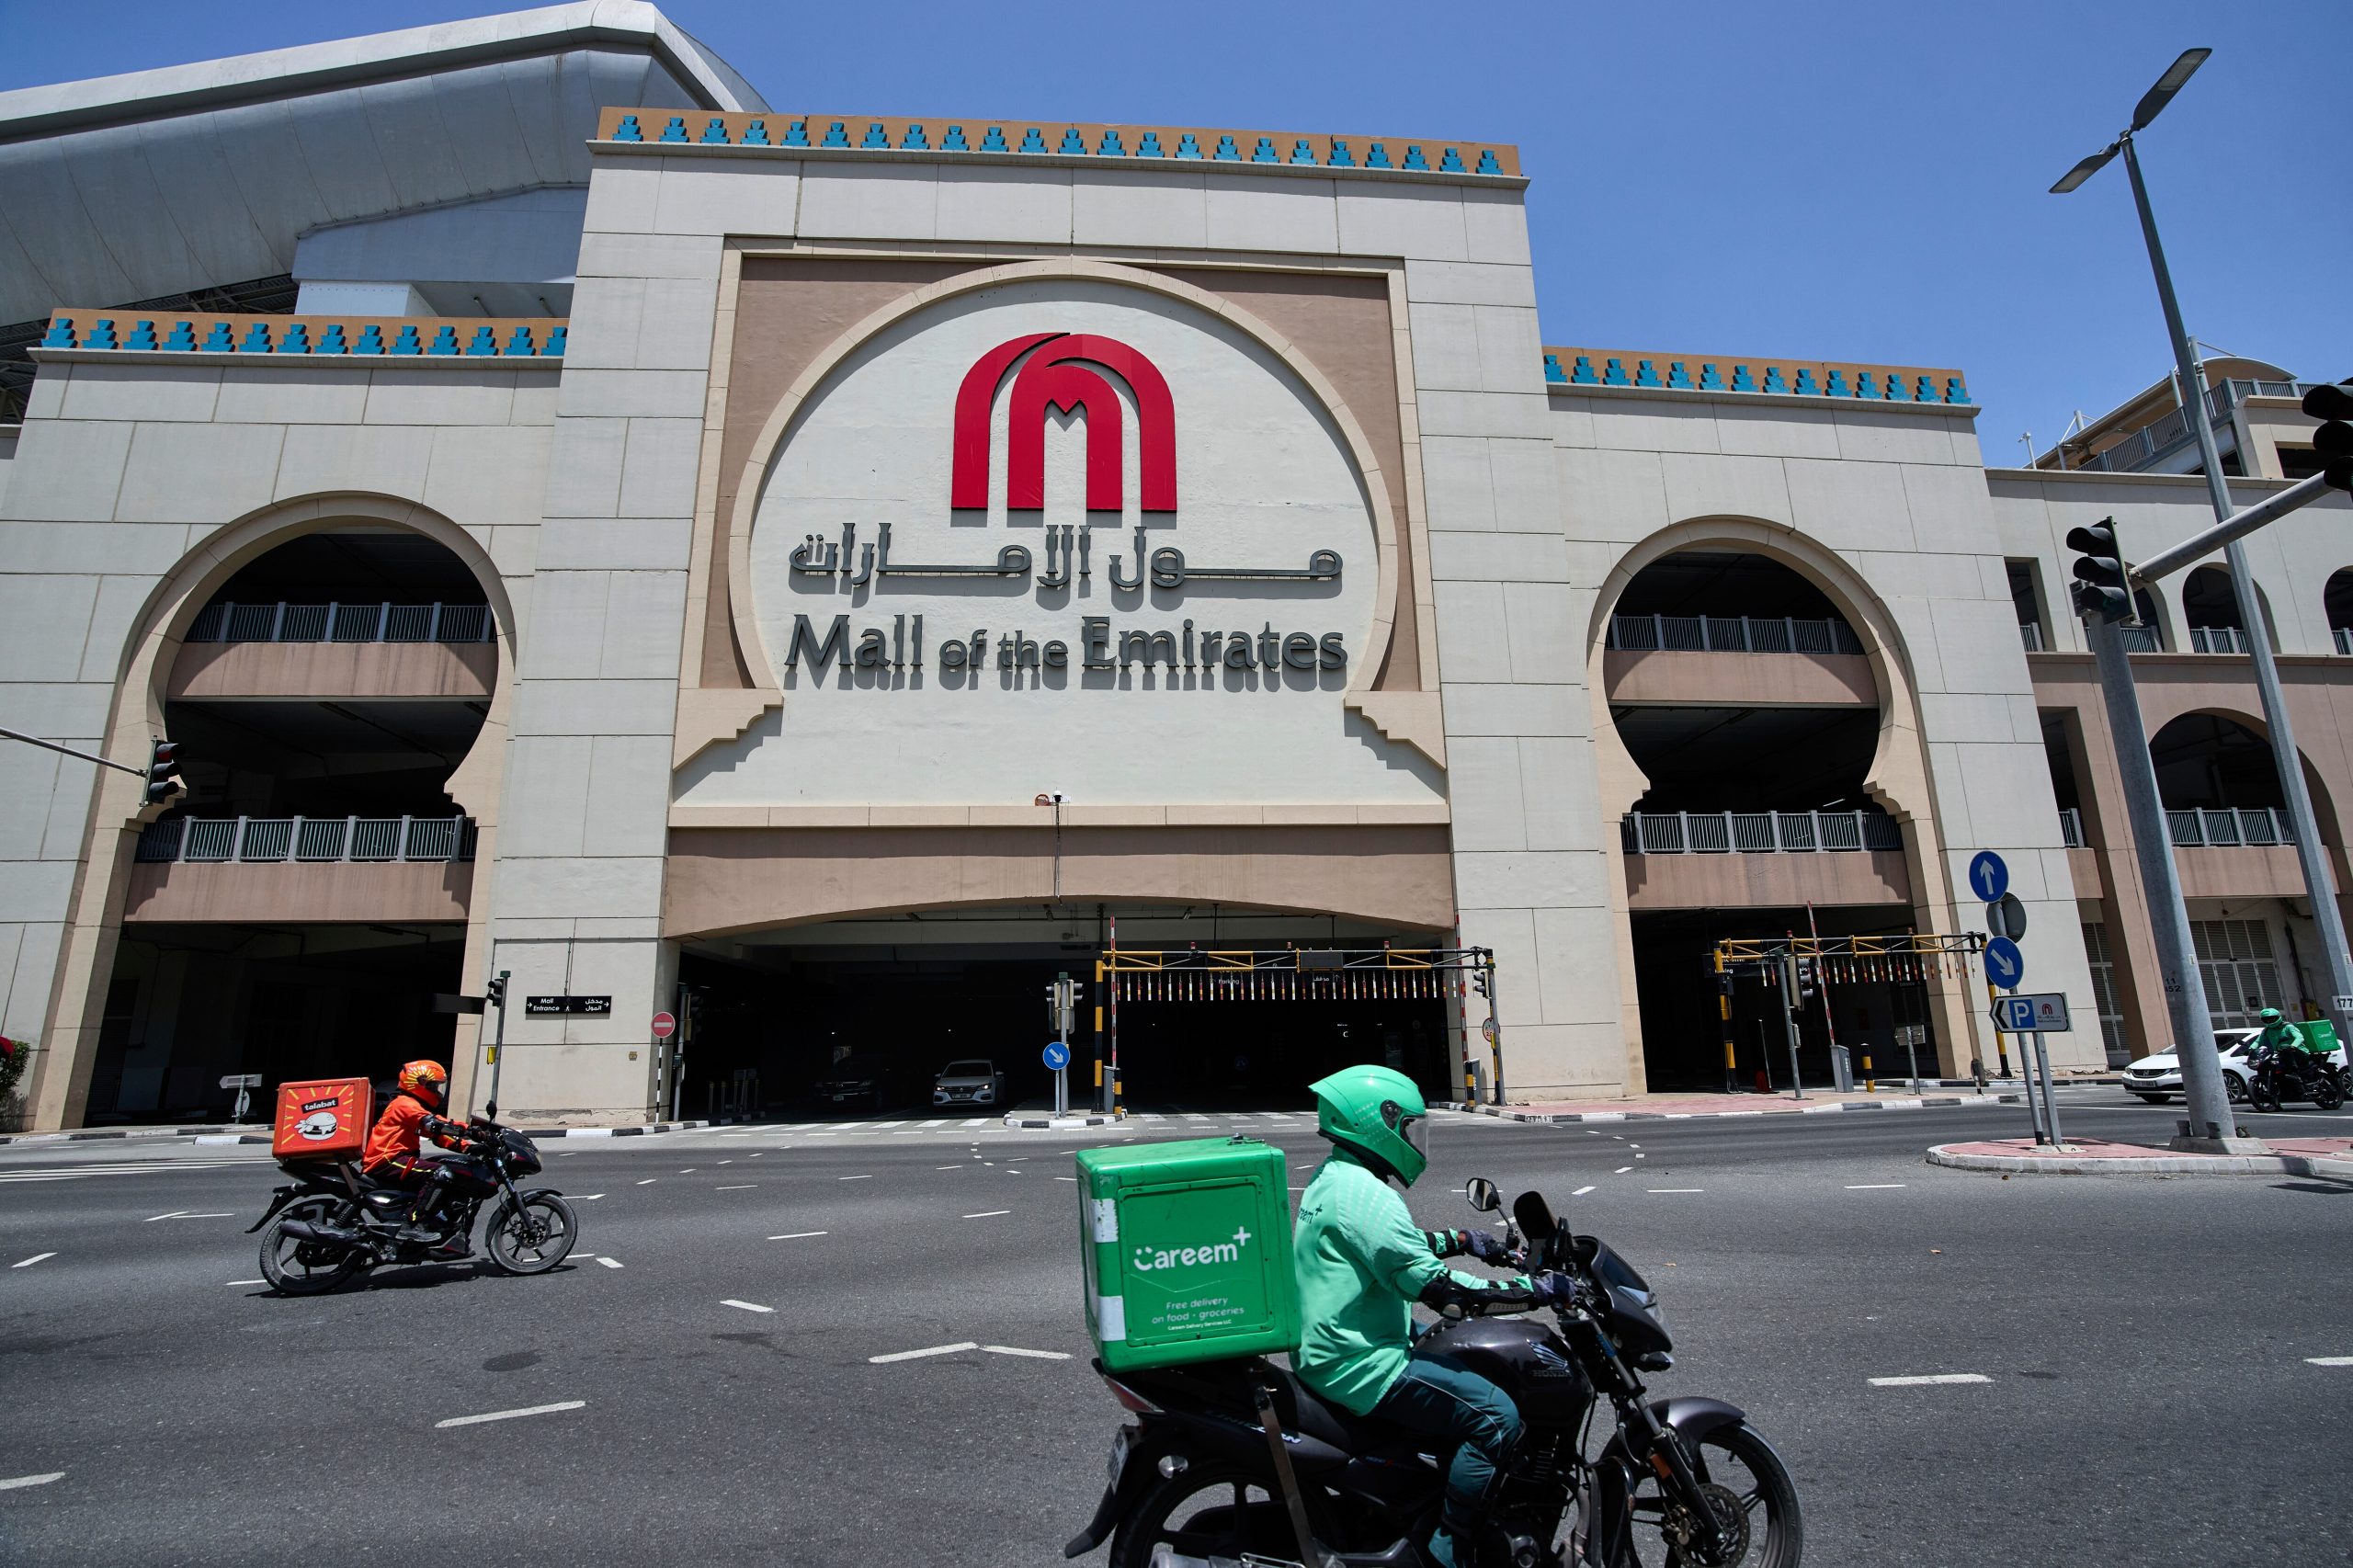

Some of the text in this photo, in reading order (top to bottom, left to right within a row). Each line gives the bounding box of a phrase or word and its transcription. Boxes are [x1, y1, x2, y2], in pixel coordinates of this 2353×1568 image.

[1109, 526, 1343, 588] مول
[784, 614, 1348, 669] Mall of the Emirates
[2013, 1002, 2029, 1027] P
[304, 1099, 336, 1111] talabat
[1165, 1297, 1228, 1311] Free delivery
[1152, 1306, 1245, 1324] on food groceries
[1531, 1369, 1573, 1378] HONDA
